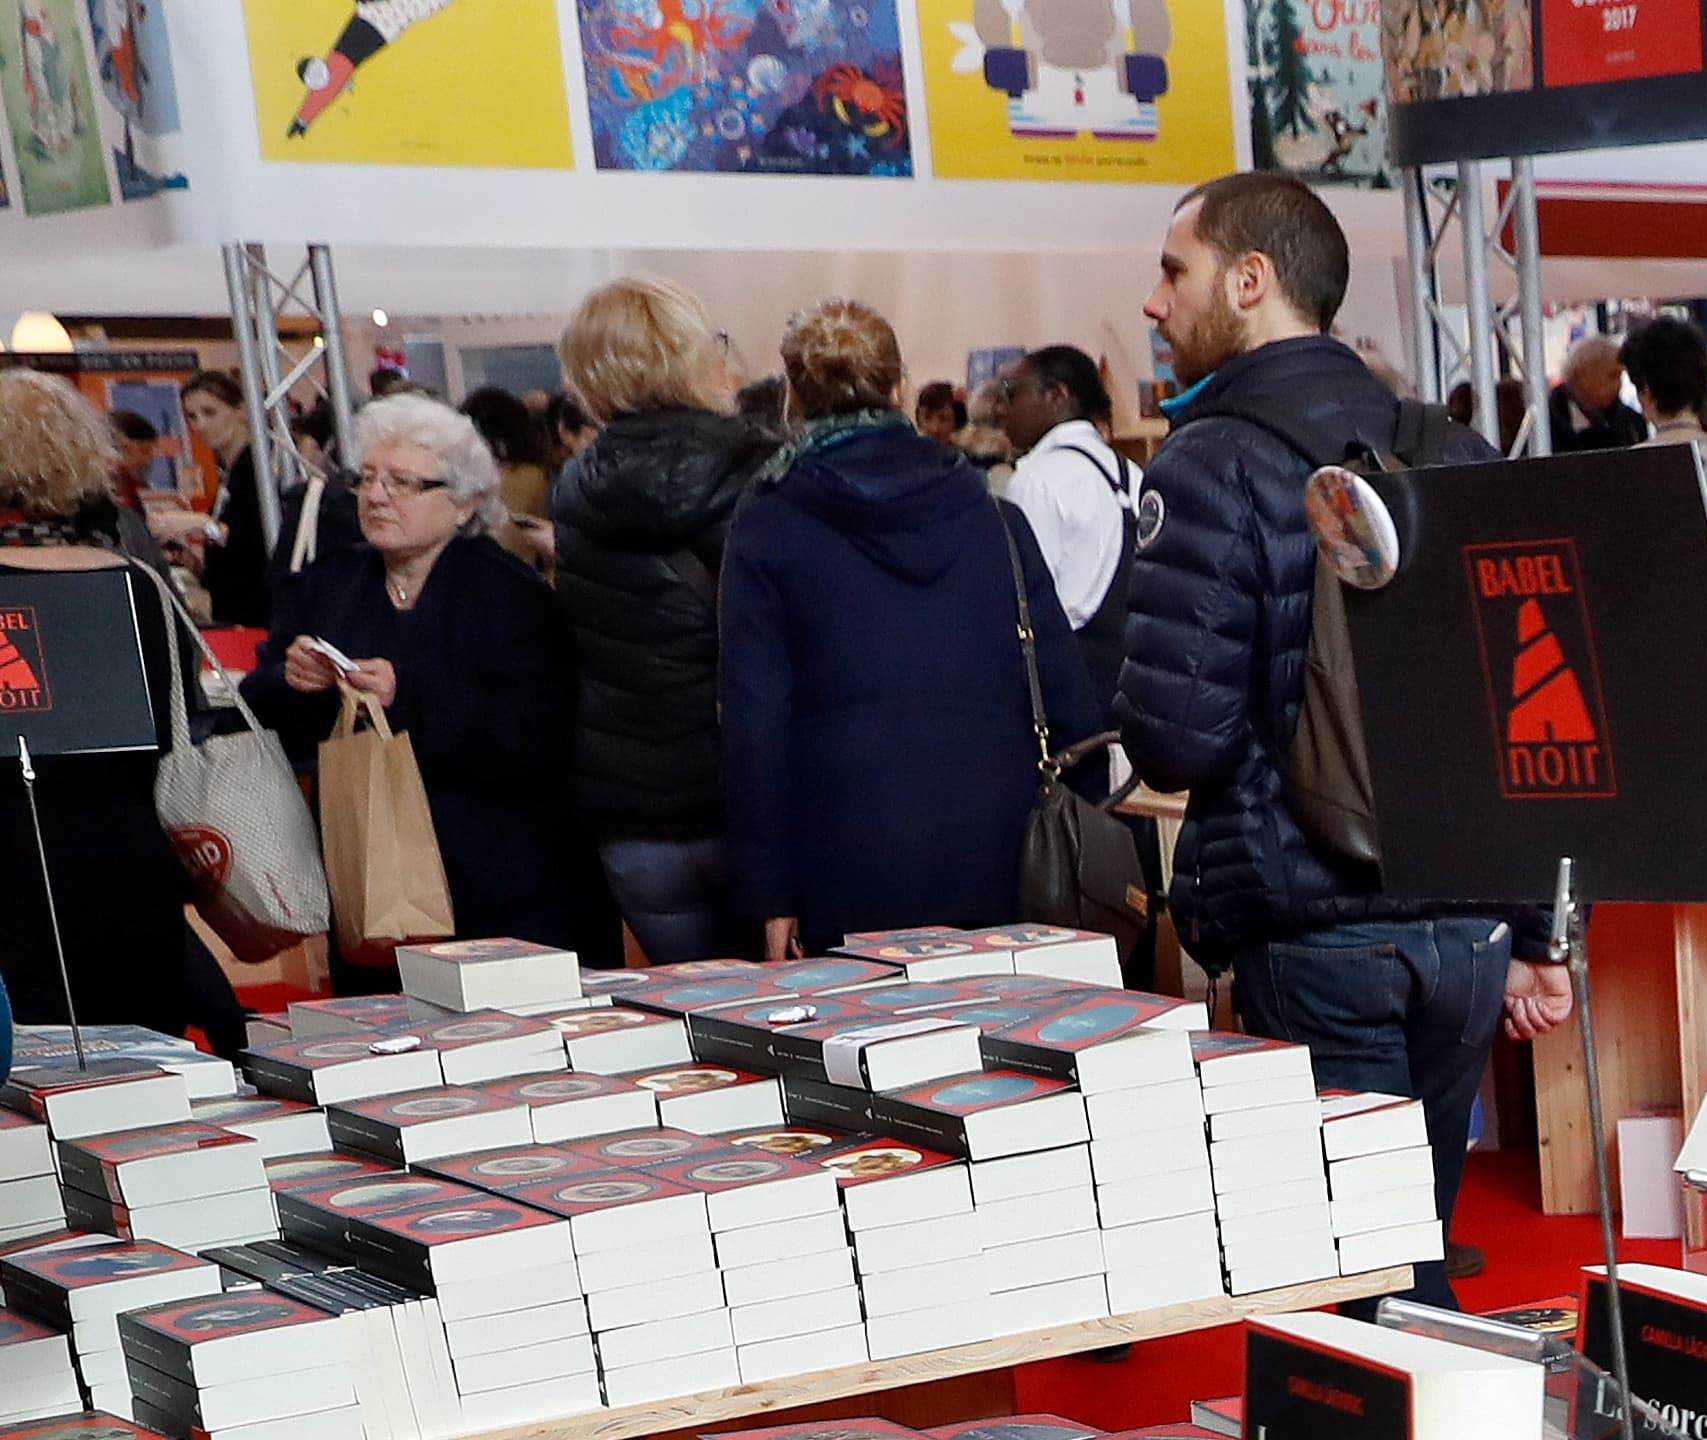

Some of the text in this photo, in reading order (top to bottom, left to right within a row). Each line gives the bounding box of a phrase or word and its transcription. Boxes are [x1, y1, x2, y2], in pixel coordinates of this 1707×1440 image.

[1603, 5, 1637, 32] 2017
[1477, 554, 1573, 598] BABEL
[0, 612, 30, 631] BEL
[0, 689, 41, 707] oir
